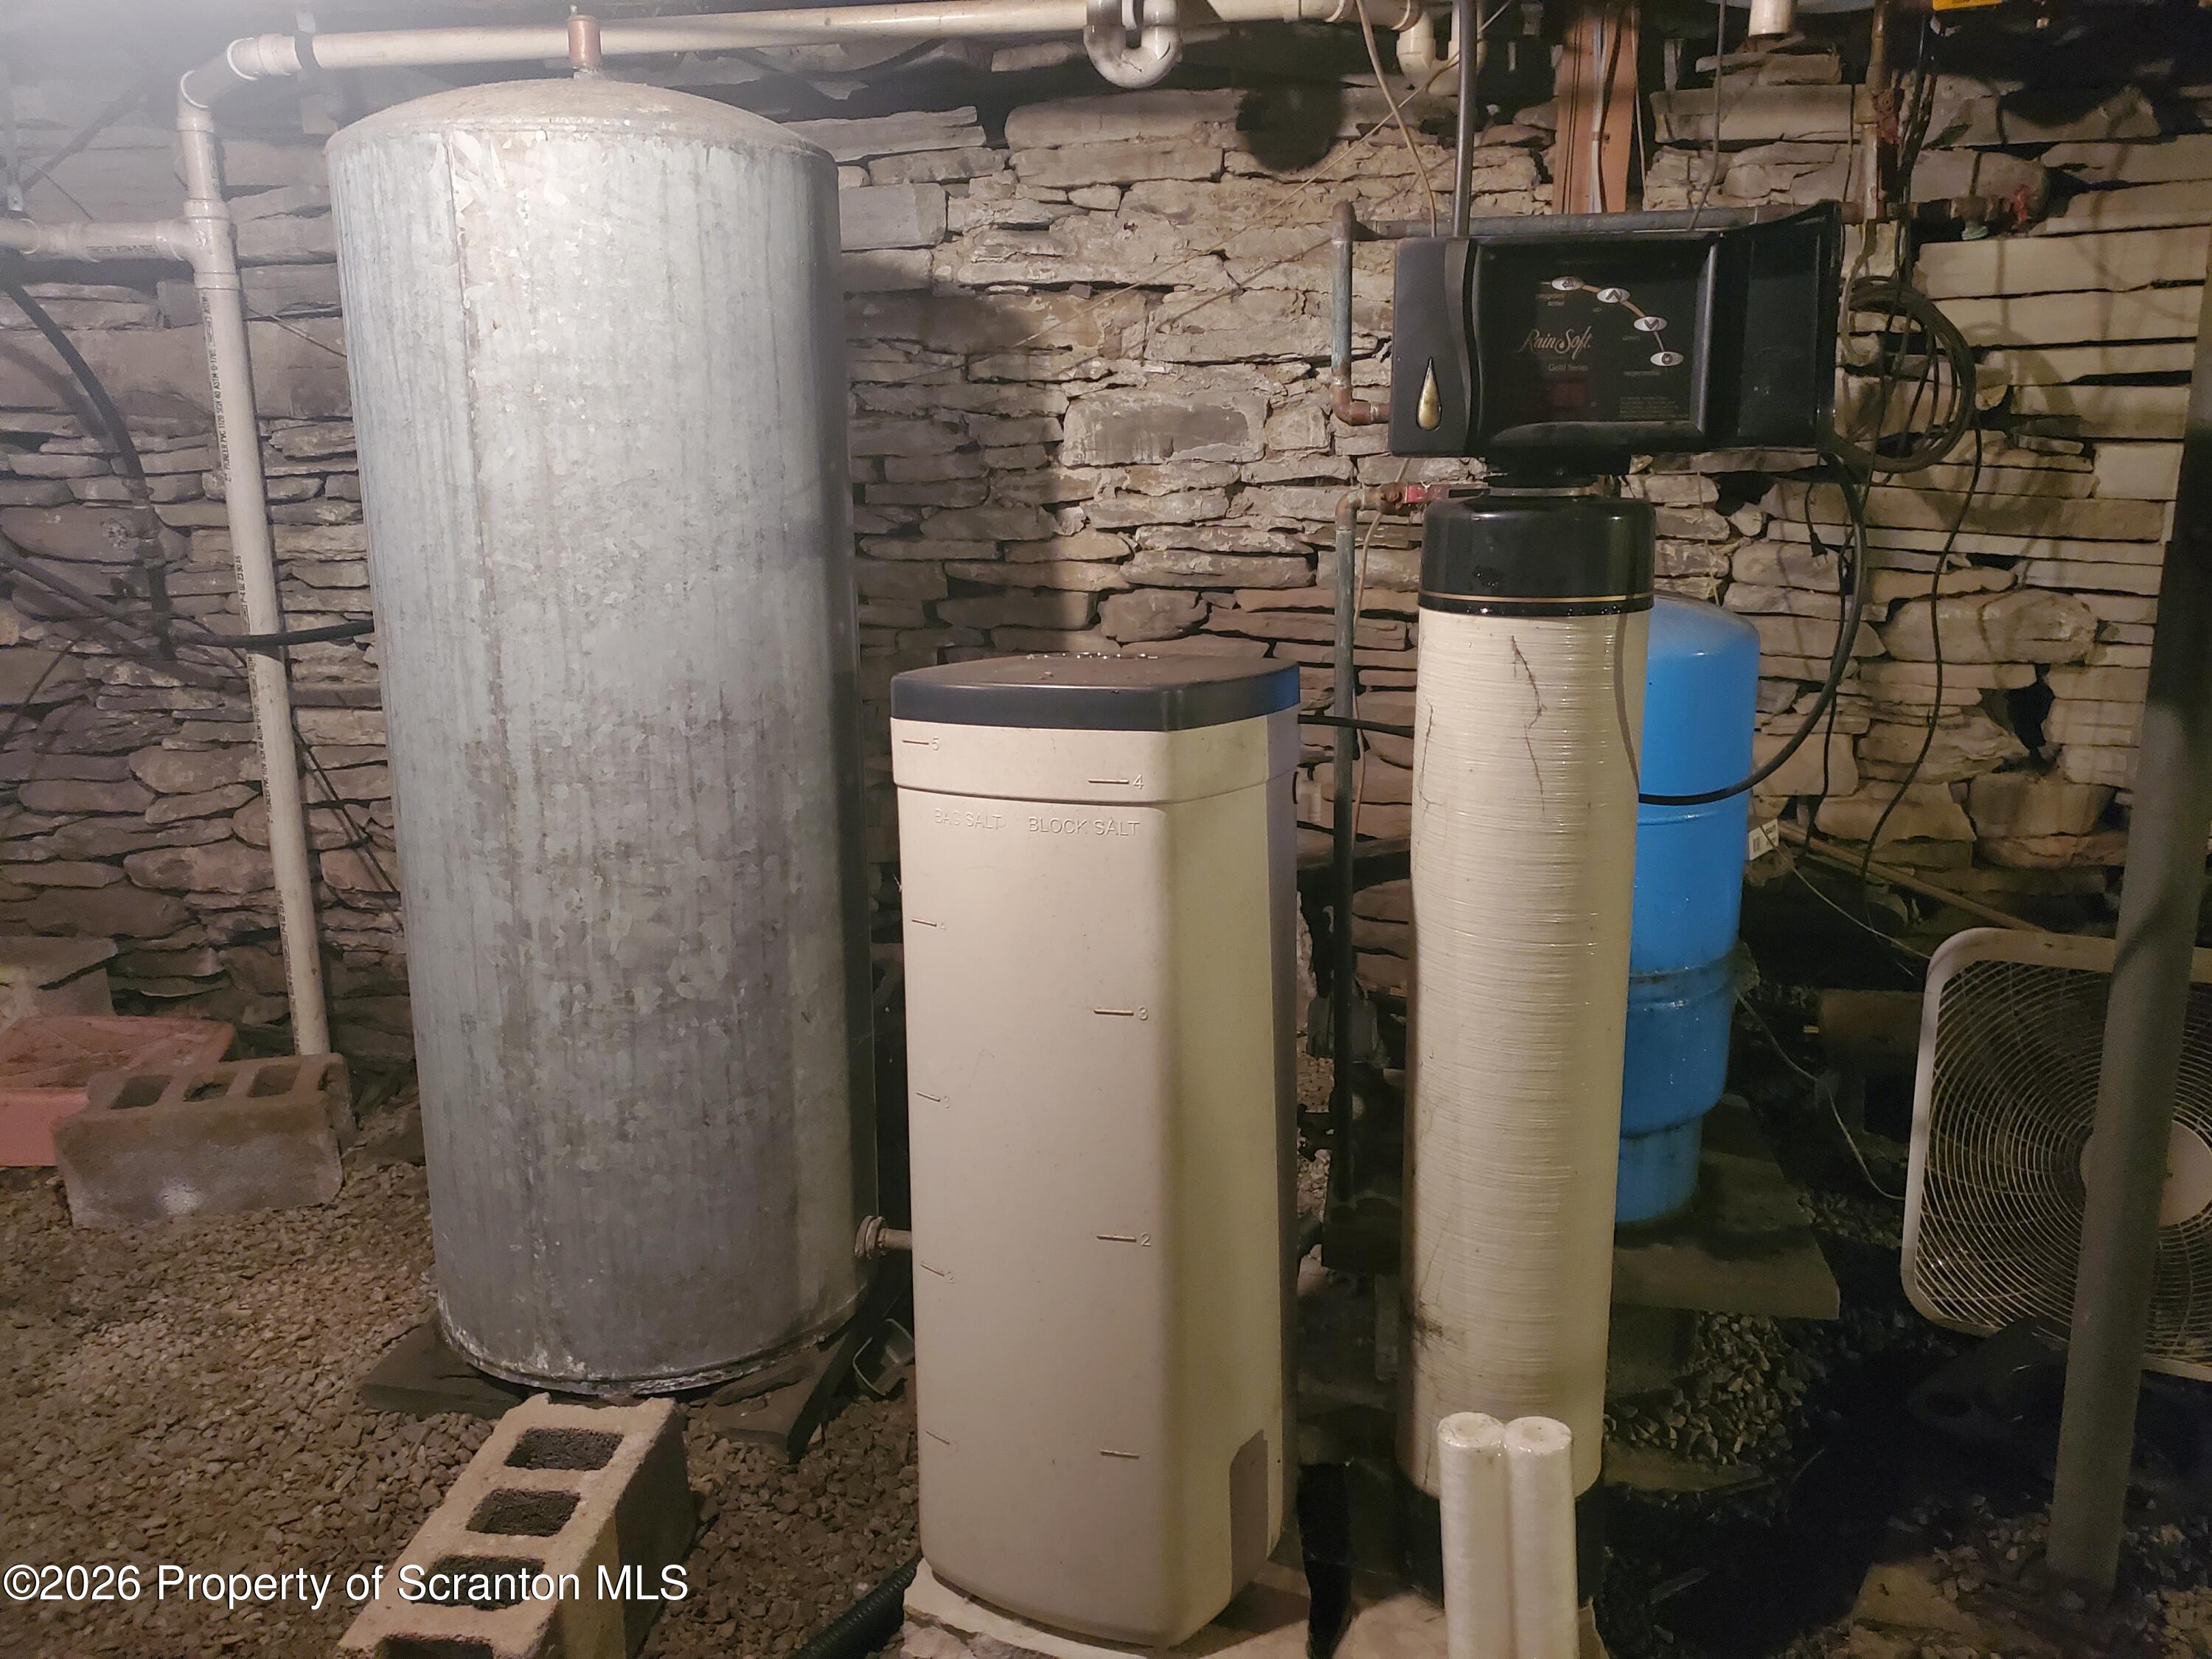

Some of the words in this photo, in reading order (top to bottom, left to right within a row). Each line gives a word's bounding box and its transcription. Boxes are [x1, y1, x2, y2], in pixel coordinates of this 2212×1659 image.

[931, 737, 939, 751] 5
[1133, 773, 1144, 790] 4
[933, 808, 961, 826] BAG
[964, 812, 1003, 830] SALT
[1027, 817, 1086, 835] BLOCK
[1093, 818, 1140, 837] SALT
[1138, 1006, 1148, 1020] 3
[1140, 1232, 1151, 1247] 2
